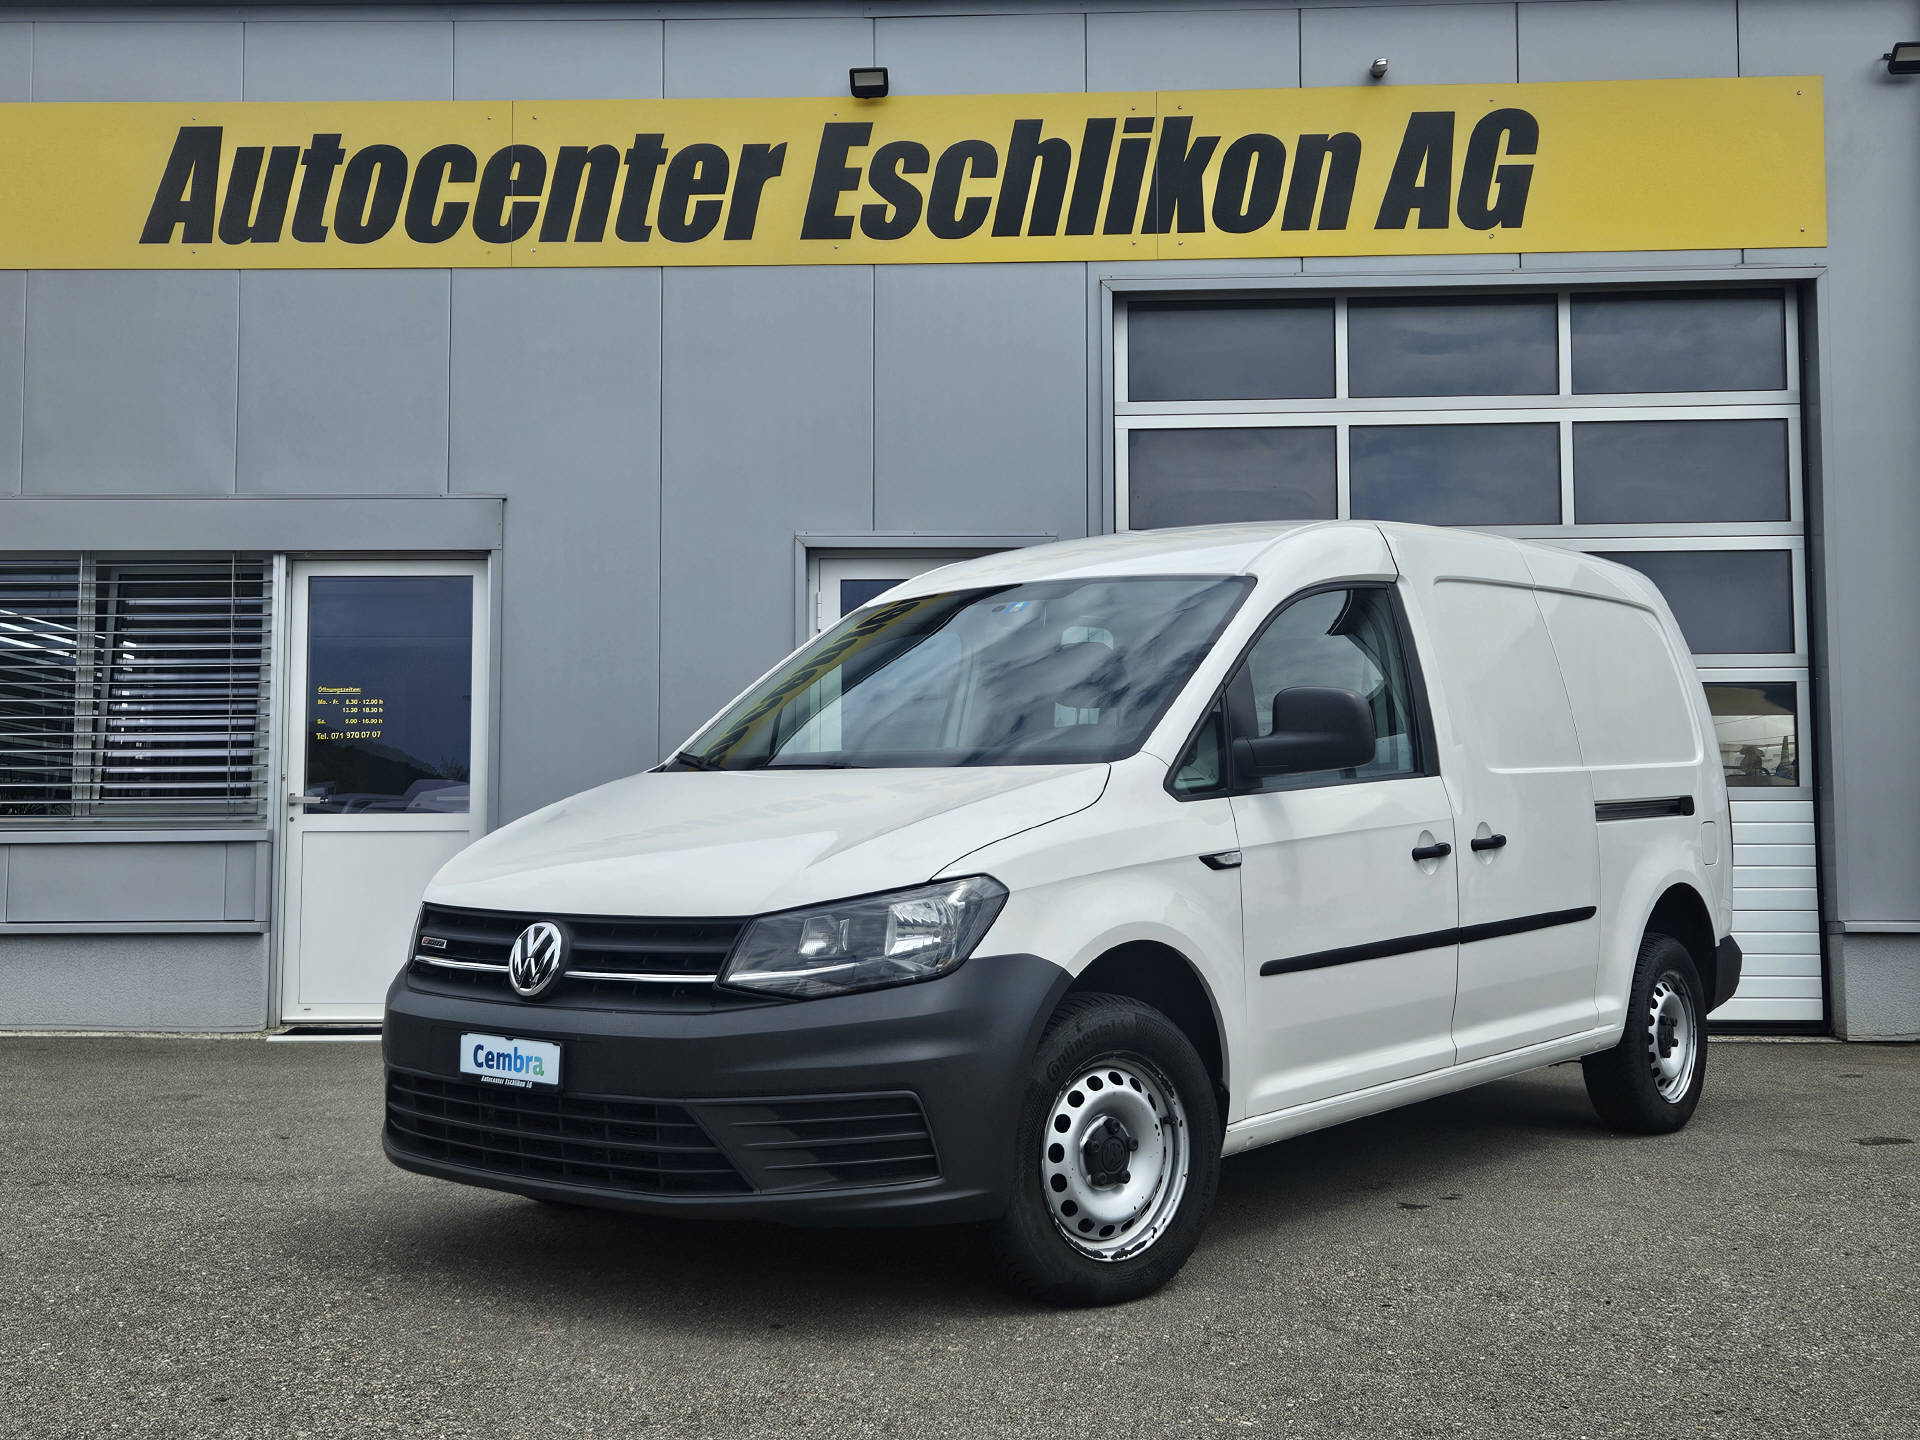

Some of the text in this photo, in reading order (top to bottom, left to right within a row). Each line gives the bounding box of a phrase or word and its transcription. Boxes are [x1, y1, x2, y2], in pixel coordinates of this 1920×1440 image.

[138, 107, 1540, 245] Autocenter Eschlikon AG
[316, 732, 329, 740] Tel.
[330, 732, 344, 740] 071
[346, 731, 360, 739] 970
[371, 730, 381, 738] 07
[473, 1043, 544, 1076] Cembra
